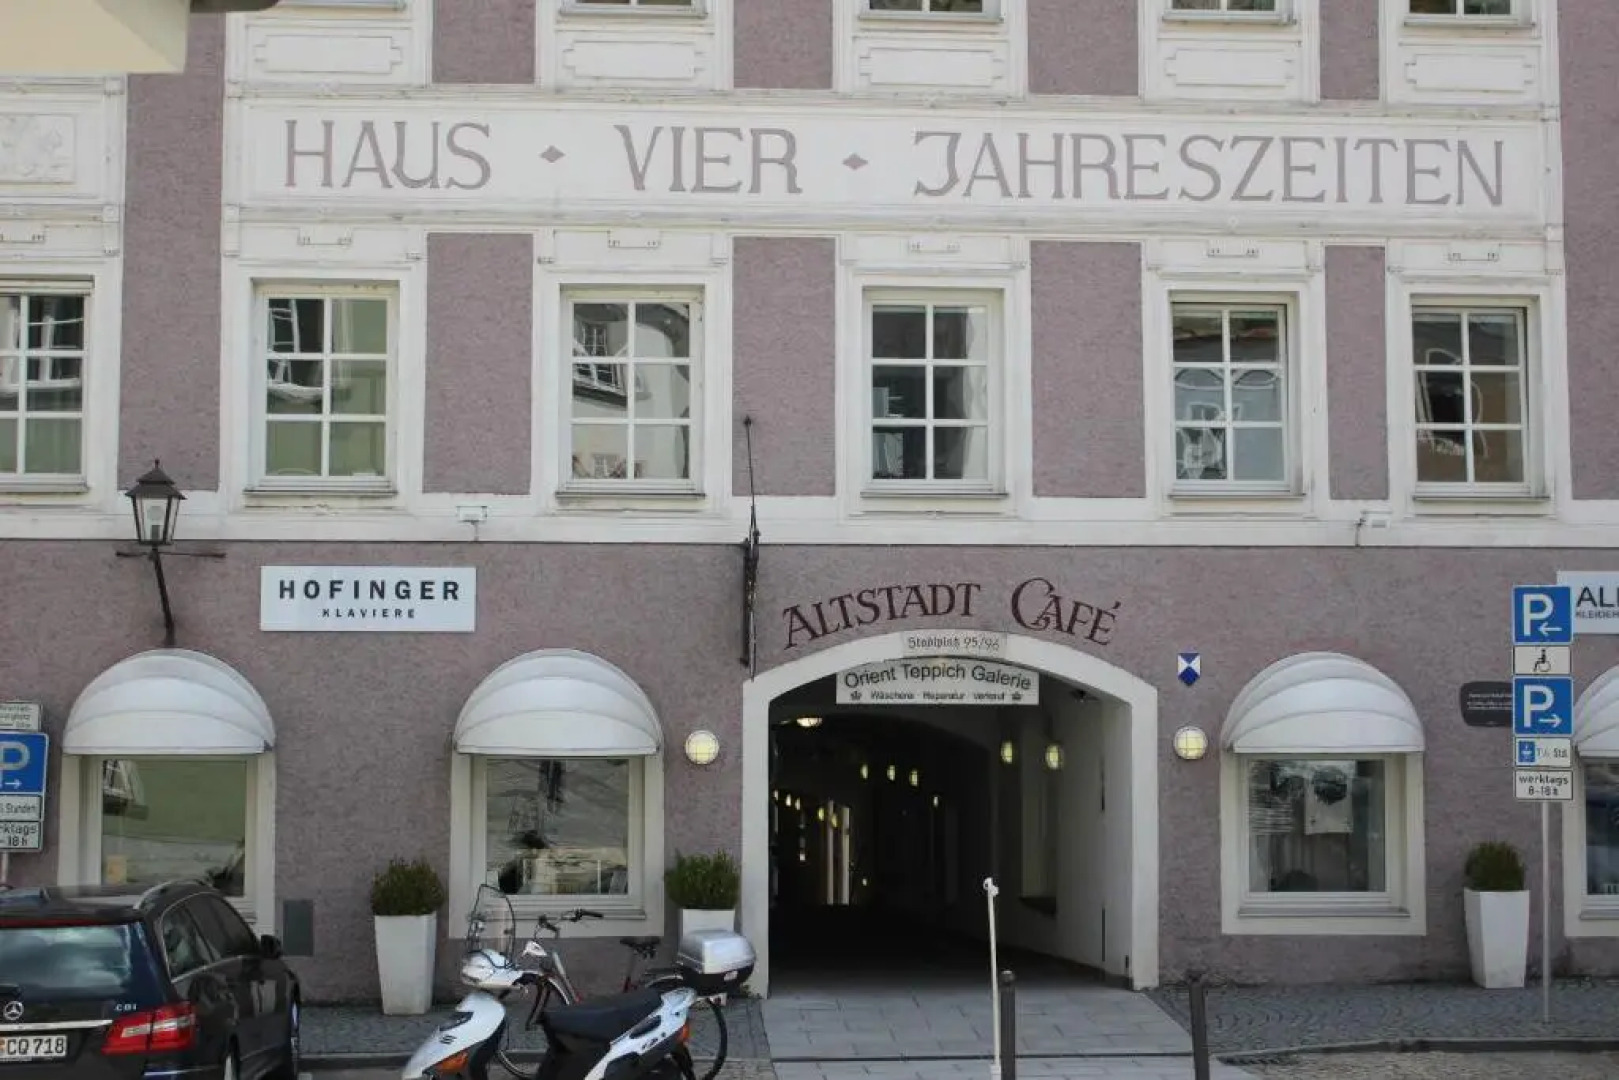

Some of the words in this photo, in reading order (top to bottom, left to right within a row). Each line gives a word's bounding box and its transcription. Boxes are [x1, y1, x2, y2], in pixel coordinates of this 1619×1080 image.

[285, 120, 492, 189] HAUS
[614, 124, 803, 194] VIER
[914, 131, 1504, 205] JAHRESZEITEN
[279, 579, 460, 600] HOFINGER
[1577, 586, 1619, 607] AL
[322, 608, 415, 618] KLAVIERE
[783, 583, 981, 650] ALTSTADT
[1011, 578, 1122, 646] CAFÉ
[1523, 593, 1554, 636] P
[845, 667, 897, 688] Orient
[902, 663, 965, 681] Teppich
[971, 665, 1031, 690] Galerie
[1523, 684, 1554, 728] P
[1519, 774, 1569, 787] werktags
[33, 1037, 64, 1054] 718
